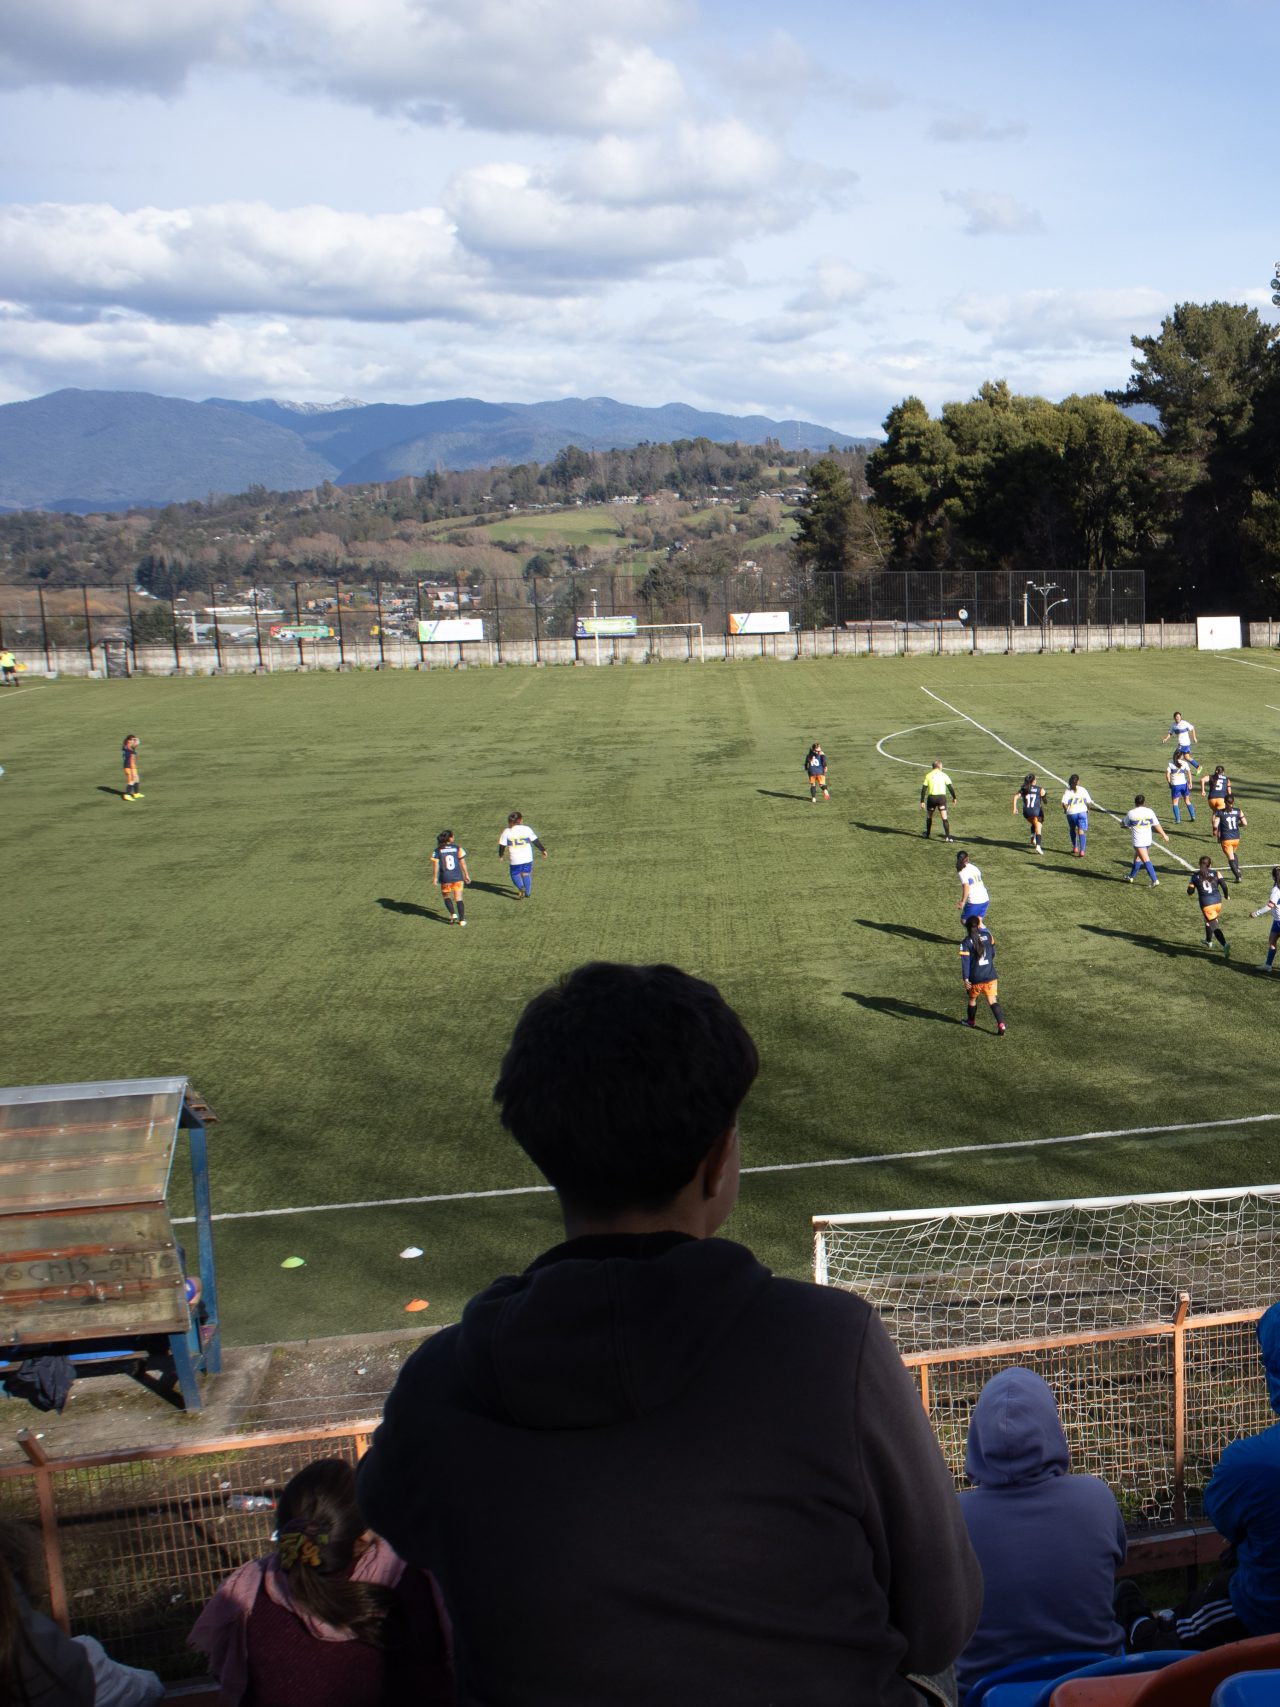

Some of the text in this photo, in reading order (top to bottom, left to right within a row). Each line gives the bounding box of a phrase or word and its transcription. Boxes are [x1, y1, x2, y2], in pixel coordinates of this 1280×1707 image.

[1215, 779, 1224, 791] 5
[1025, 793, 1037, 808] 17
[1226, 816, 1238, 830] 11
[446, 855, 456, 871] 8
[1202, 880, 1213, 894] 9
